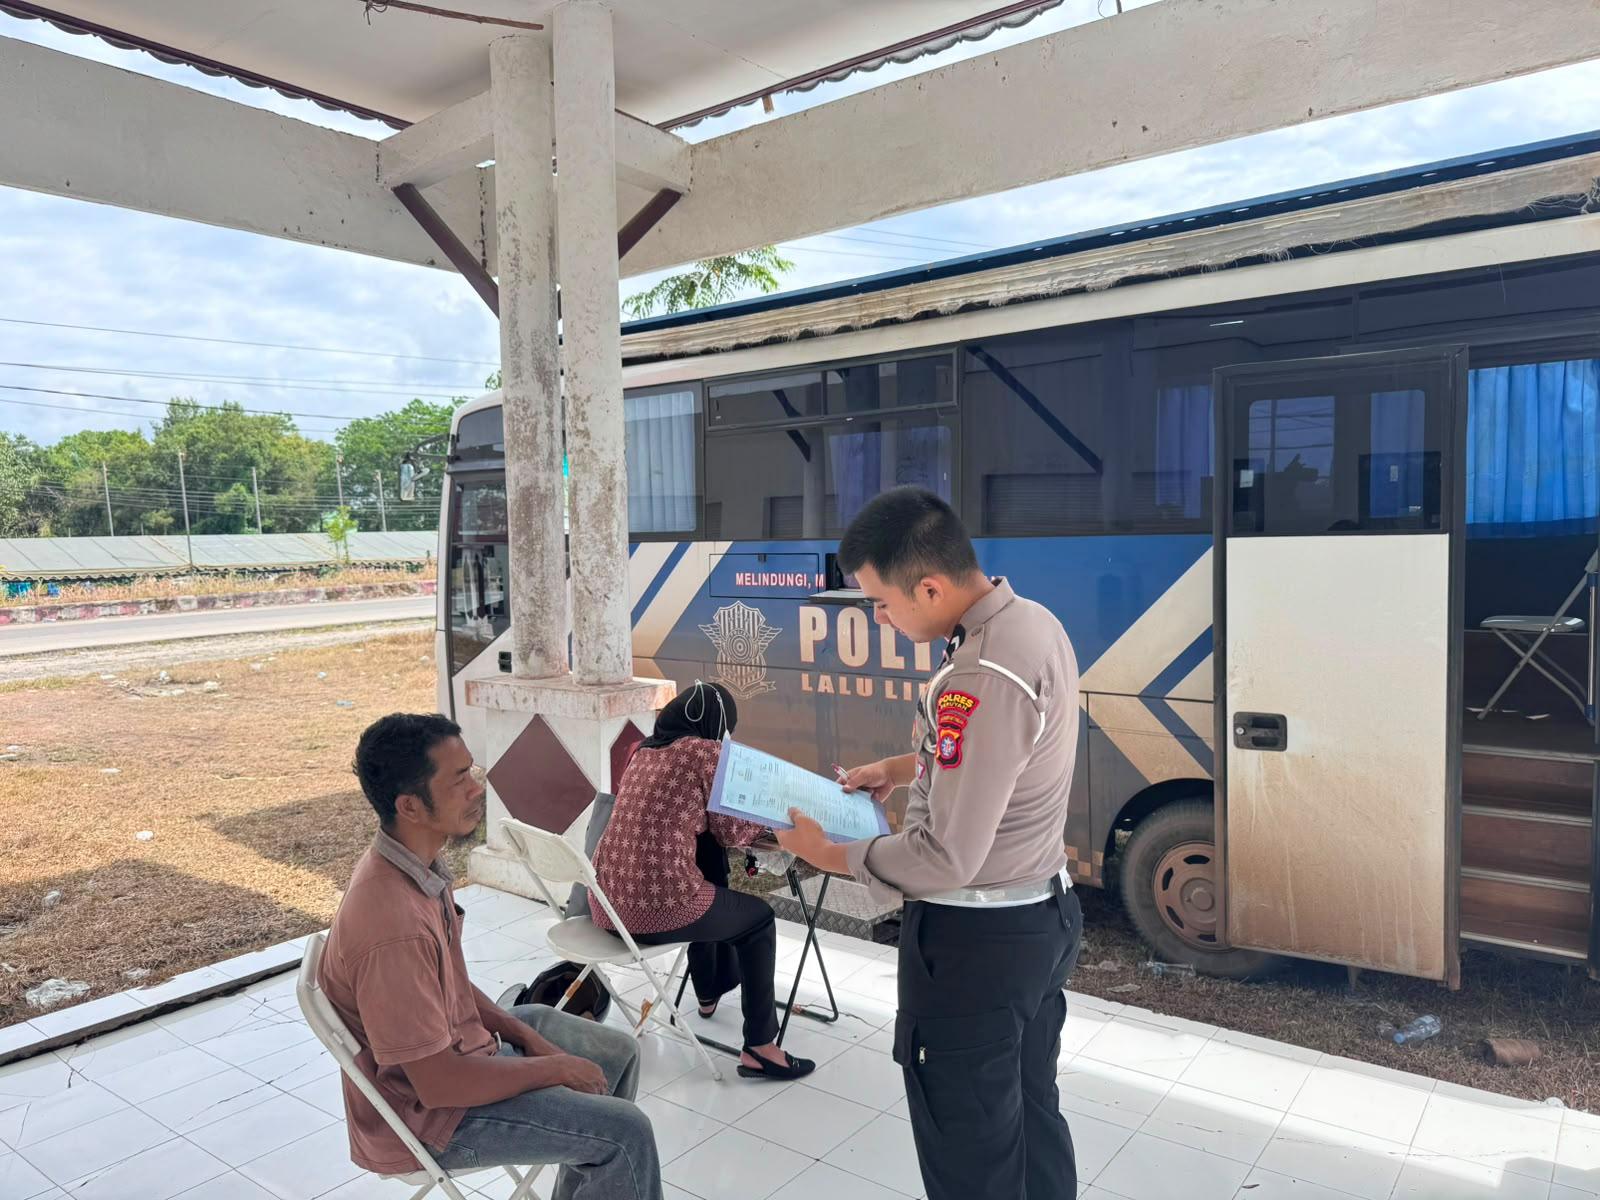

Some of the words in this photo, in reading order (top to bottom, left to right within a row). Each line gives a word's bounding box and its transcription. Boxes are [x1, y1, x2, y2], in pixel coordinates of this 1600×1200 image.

[735, 572, 811, 589] MELINDUNGI,
[801, 672, 873, 697] LALU
[938, 693, 974, 708] POLRES
